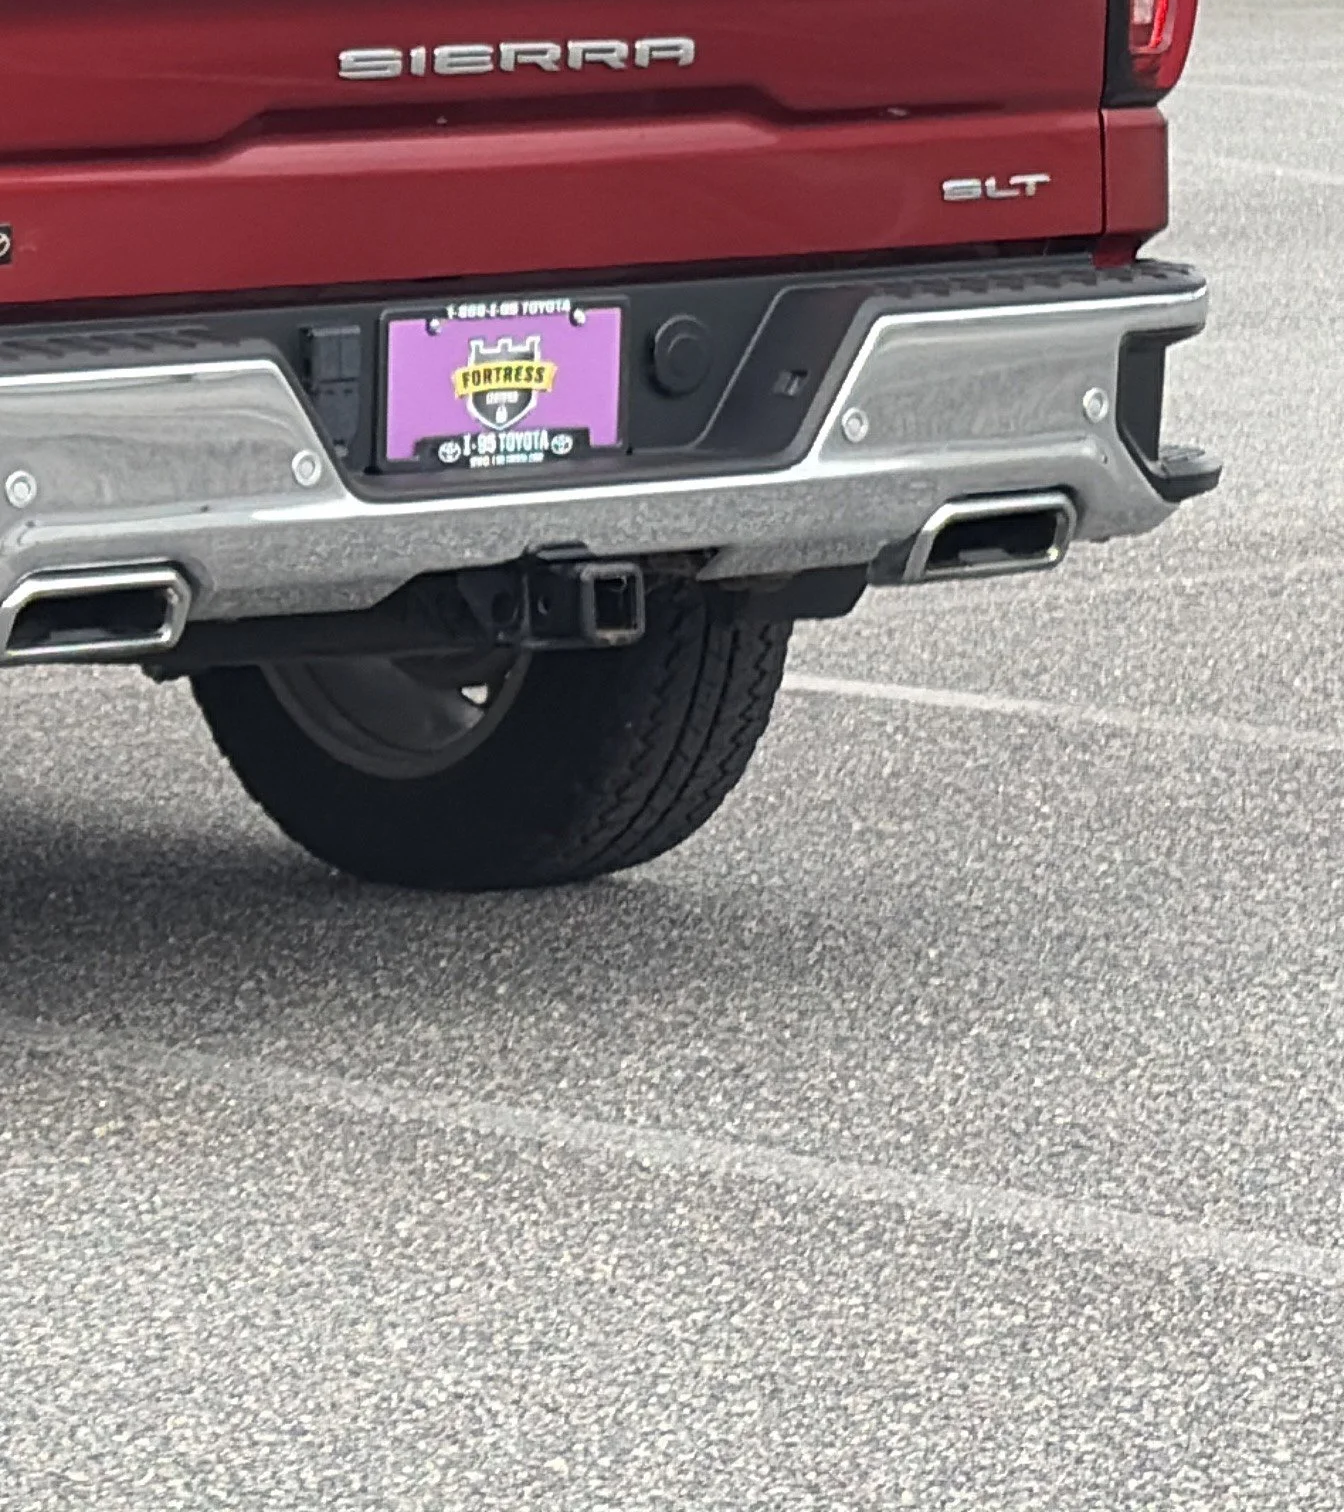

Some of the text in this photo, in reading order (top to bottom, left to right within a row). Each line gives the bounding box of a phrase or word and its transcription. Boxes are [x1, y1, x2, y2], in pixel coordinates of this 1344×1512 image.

[338, 37, 696, 80] SIERRA
[942, 173, 1051, 201] SLT
[522, 298, 570, 316] TOYOTA
[462, 365, 546, 389] FORTRESS
[498, 429, 550, 452] TOYOTA
